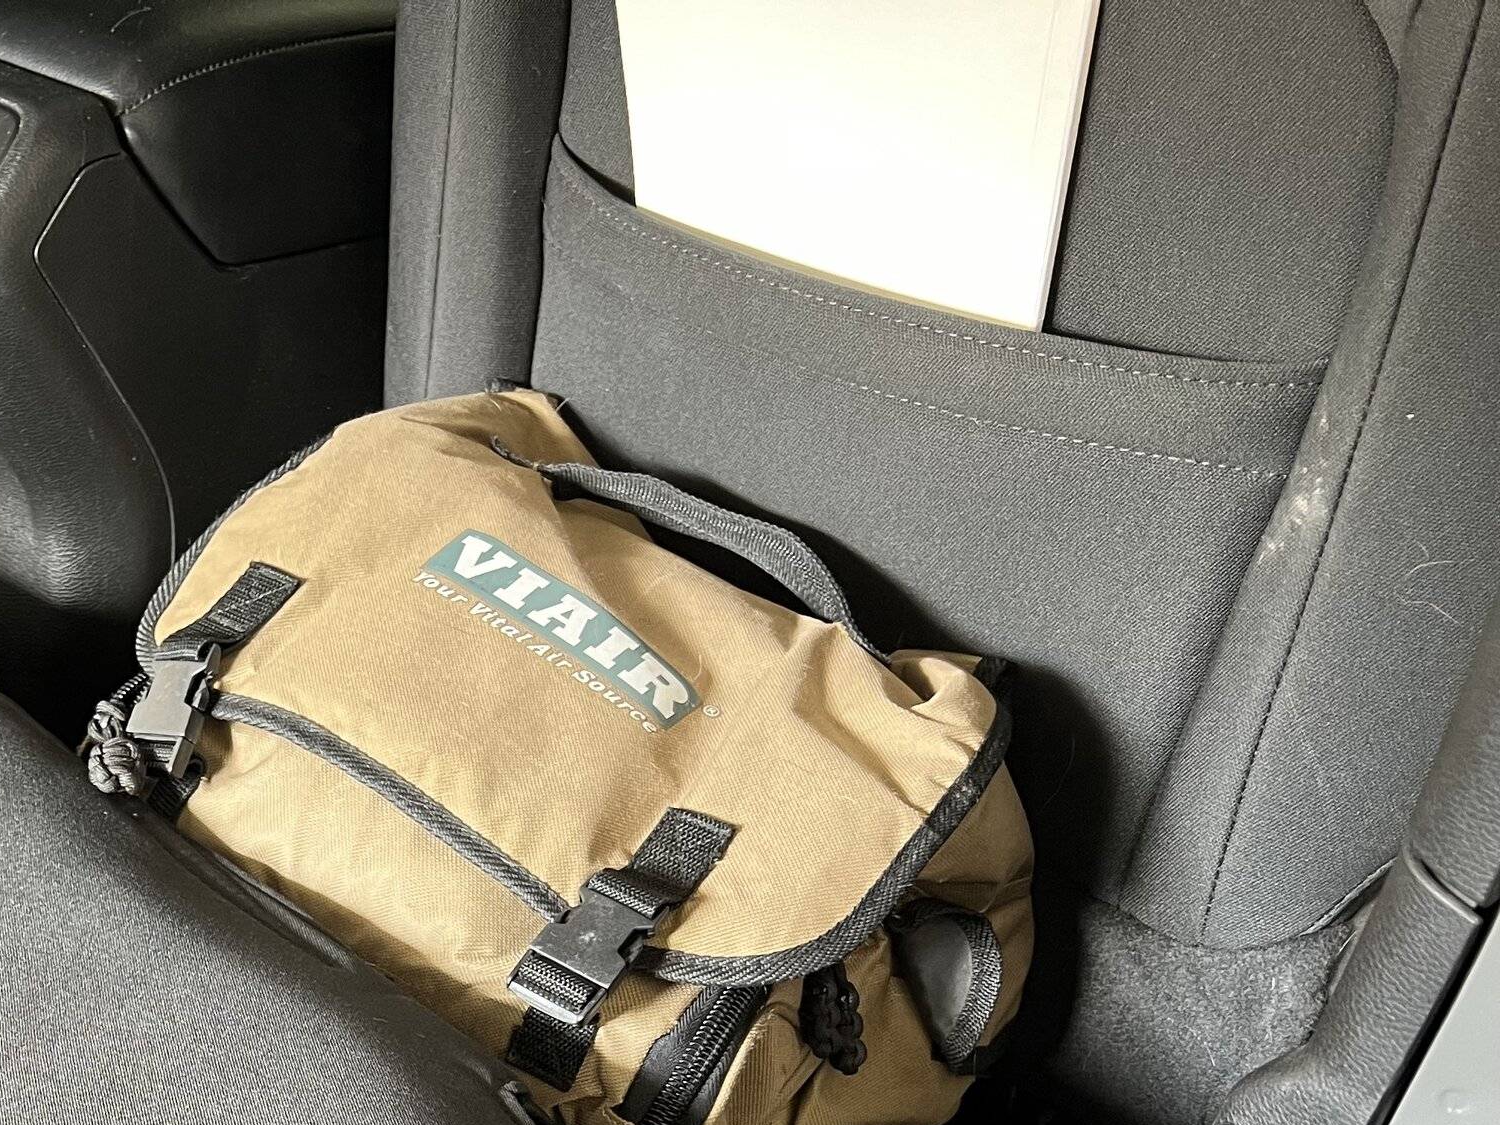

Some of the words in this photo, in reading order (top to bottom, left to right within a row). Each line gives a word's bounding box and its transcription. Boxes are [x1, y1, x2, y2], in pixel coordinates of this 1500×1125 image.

[412, 571, 469, 603] Your
[469, 602, 533, 644] Vital
[527, 643, 573, 670] Air
[571, 669, 658, 734] Source
[453, 535, 689, 720] VIAIR
